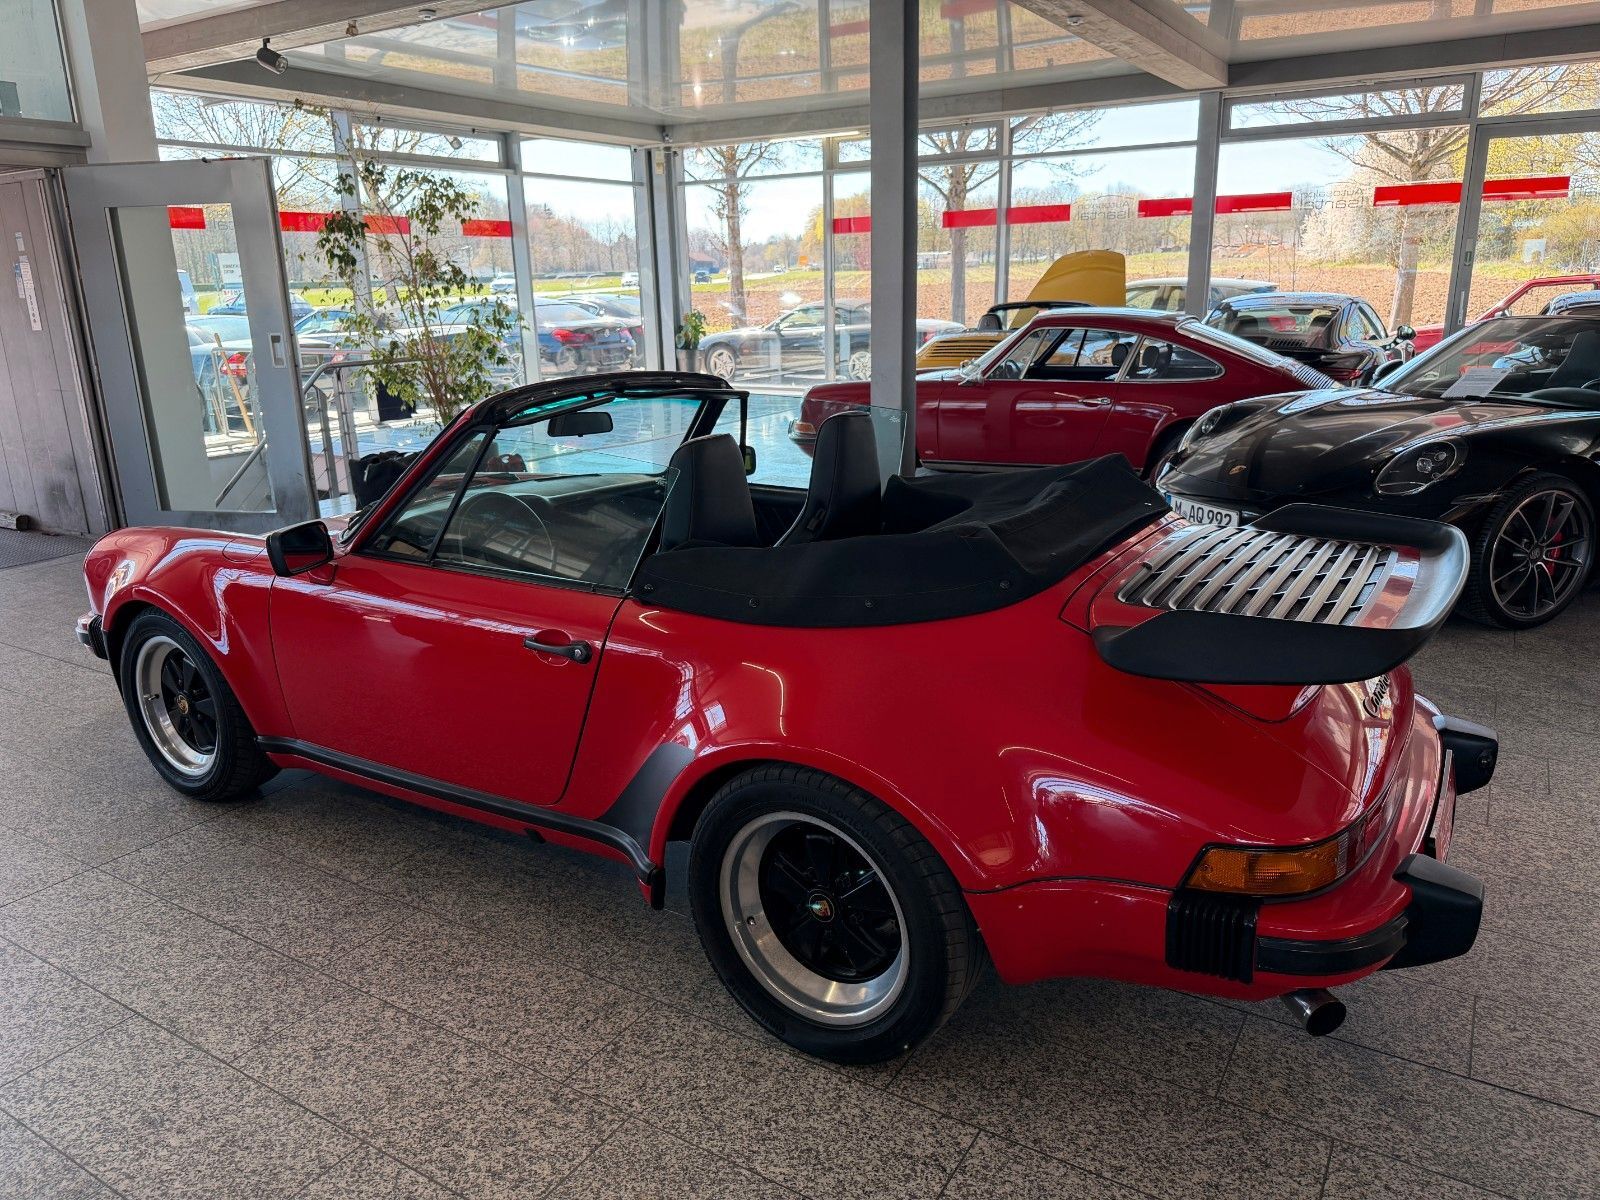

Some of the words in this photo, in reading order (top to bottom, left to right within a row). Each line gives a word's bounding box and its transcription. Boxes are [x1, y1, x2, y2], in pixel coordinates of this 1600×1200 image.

[1174, 500, 1182, 515] M
[1188, 504, 1204, 524] AQ
[1207, 509, 1232, 526] 992
